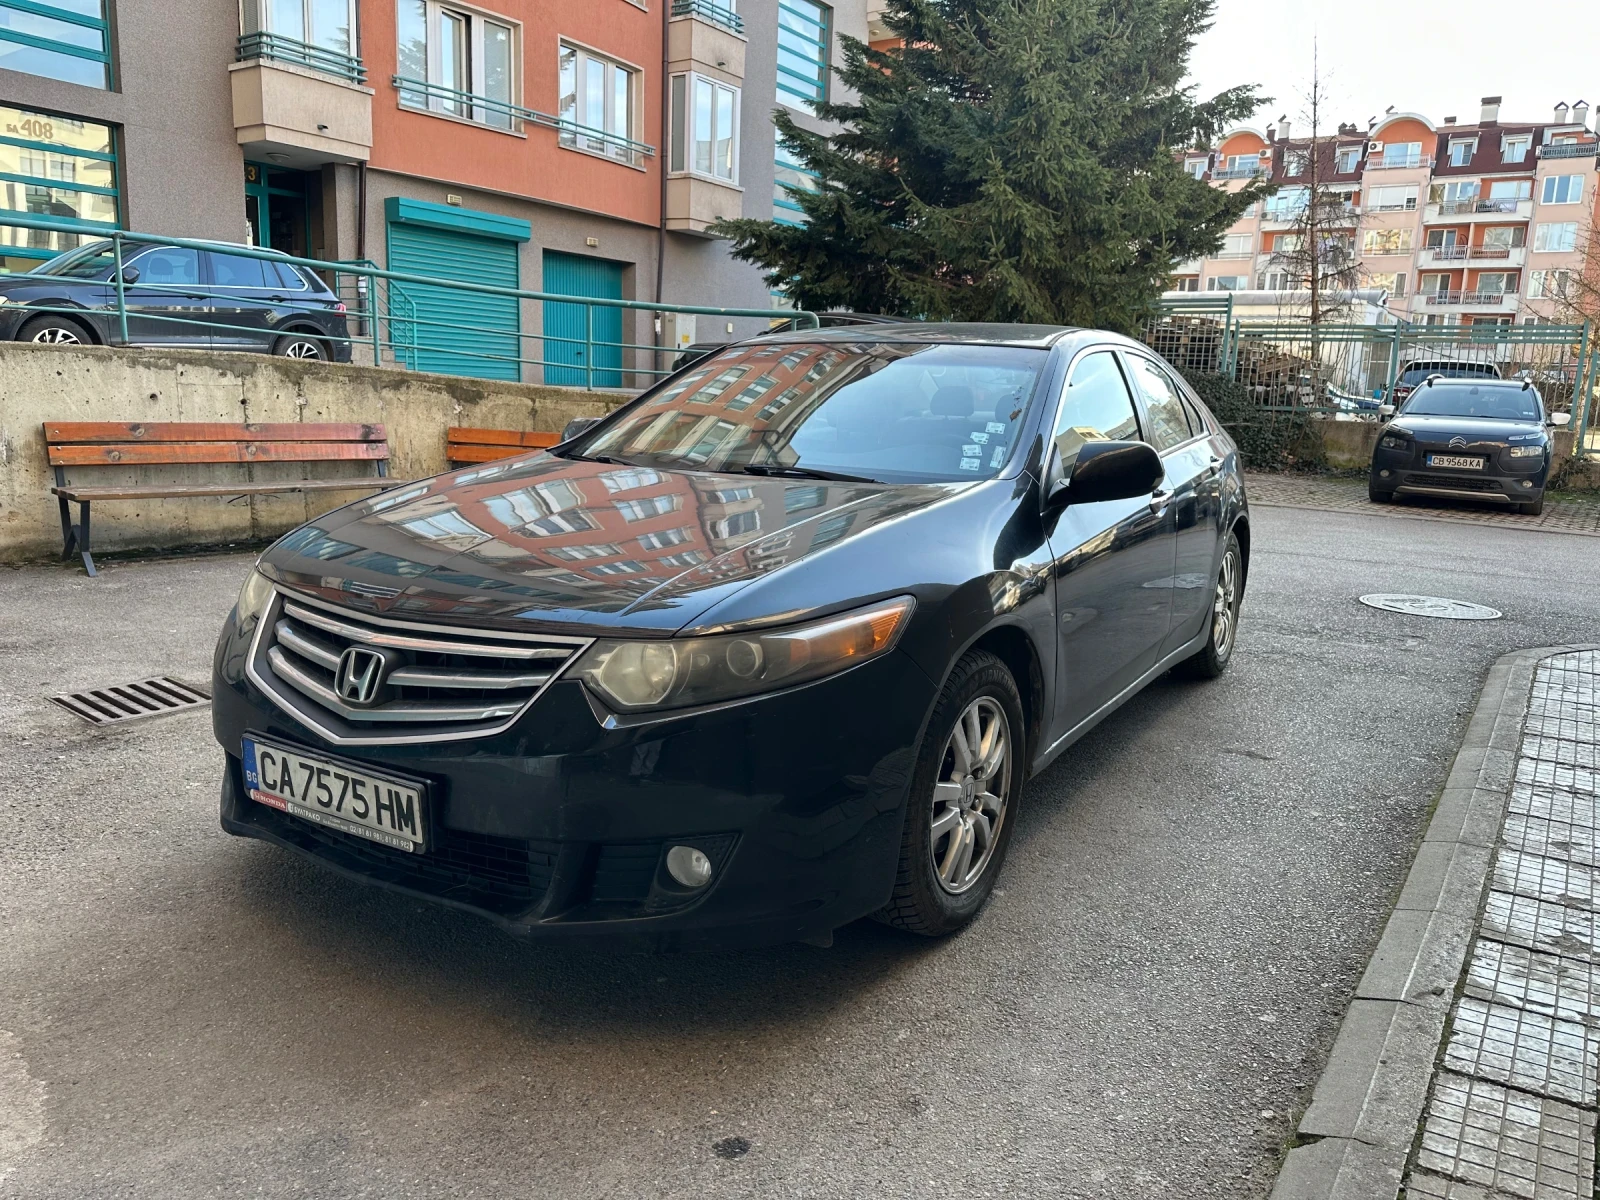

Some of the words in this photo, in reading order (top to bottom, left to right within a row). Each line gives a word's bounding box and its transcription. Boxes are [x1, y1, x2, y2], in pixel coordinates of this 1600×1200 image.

[20, 119, 53, 139] 408
[247, 166, 256, 181] 3
[246, 770, 257, 784] BG
[260, 795, 286, 809] HONDA
